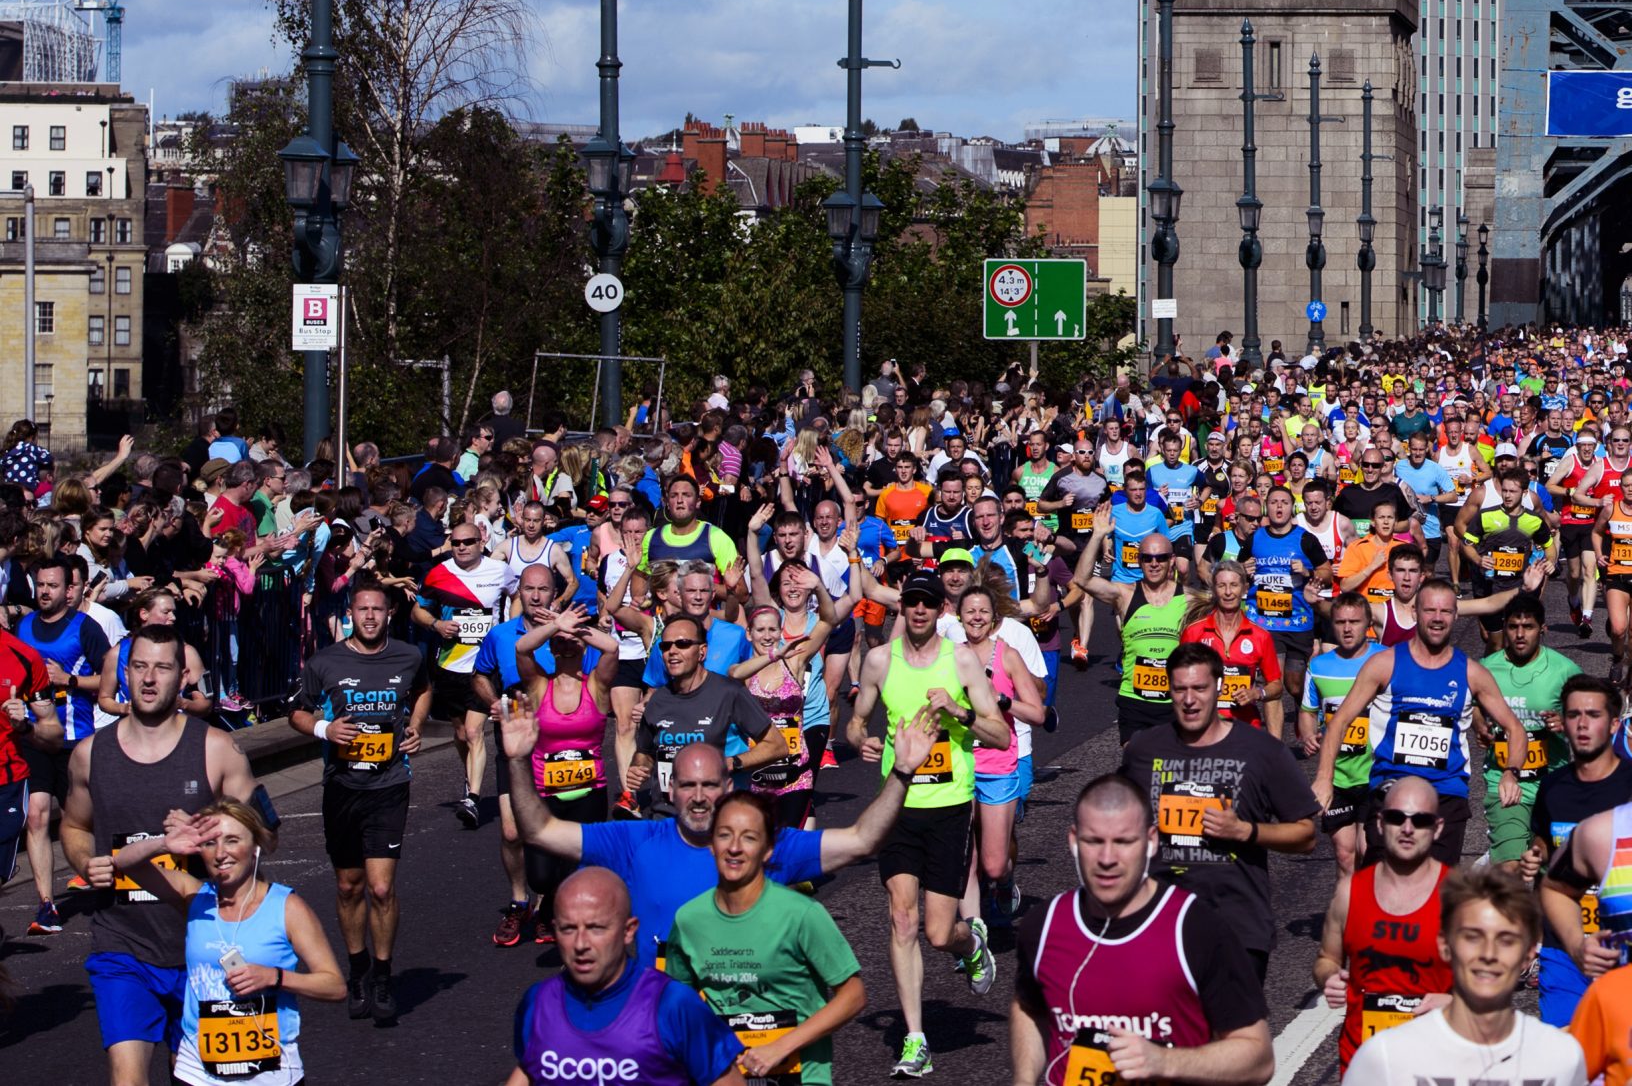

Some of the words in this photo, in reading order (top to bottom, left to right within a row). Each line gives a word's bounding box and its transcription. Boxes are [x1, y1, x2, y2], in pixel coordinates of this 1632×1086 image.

[998, 275, 1015, 285] 4.3
[591, 284, 618, 301] 40
[308, 300, 323, 317] B
[315, 327, 332, 335] Stop
[1073, 517, 1093, 526] 1375
[1494, 558, 1522, 567] 12890
[1261, 575, 1285, 584] LUKE
[1136, 673, 1168, 686] 1288
[343, 688, 397, 704] Team
[345, 702, 375, 712] Great
[377, 701, 397, 711] Run
[658, 730, 705, 745] Team
[1399, 732, 1449, 753] 17056
[1152, 758, 1185, 772] RUN
[1189, 758, 1247, 772] HAPPY
[1405, 755, 1429, 764] PUMA
[547, 767, 592, 784] 13749
[1151, 771, 1184, 785] RUN
[1188, 771, 1244, 785] HAPPY
[1174, 783, 1191, 793] great
[126, 834, 143, 844] great
[1171, 834, 1200, 846] PUMA
[1372, 920, 1420, 943] STU
[711, 947, 754, 957] Saddleworth
[704, 959, 727, 971] Sprint
[729, 959, 762, 970] Triathlon
[721, 973, 738, 983] April
[738, 972, 758, 983] 2016
[1377, 996, 1396, 1007] great
[211, 1004, 230, 1013] great
[729, 1016, 746, 1027] great
[753, 1014, 775, 1023] north
[1052, 1007, 1172, 1039] Tommy's
[202, 1027, 276, 1055] 13135
[742, 1032, 767, 1040] SHAUN
[216, 1062, 249, 1075] PUMA
[540, 1050, 639, 1086] Scope
